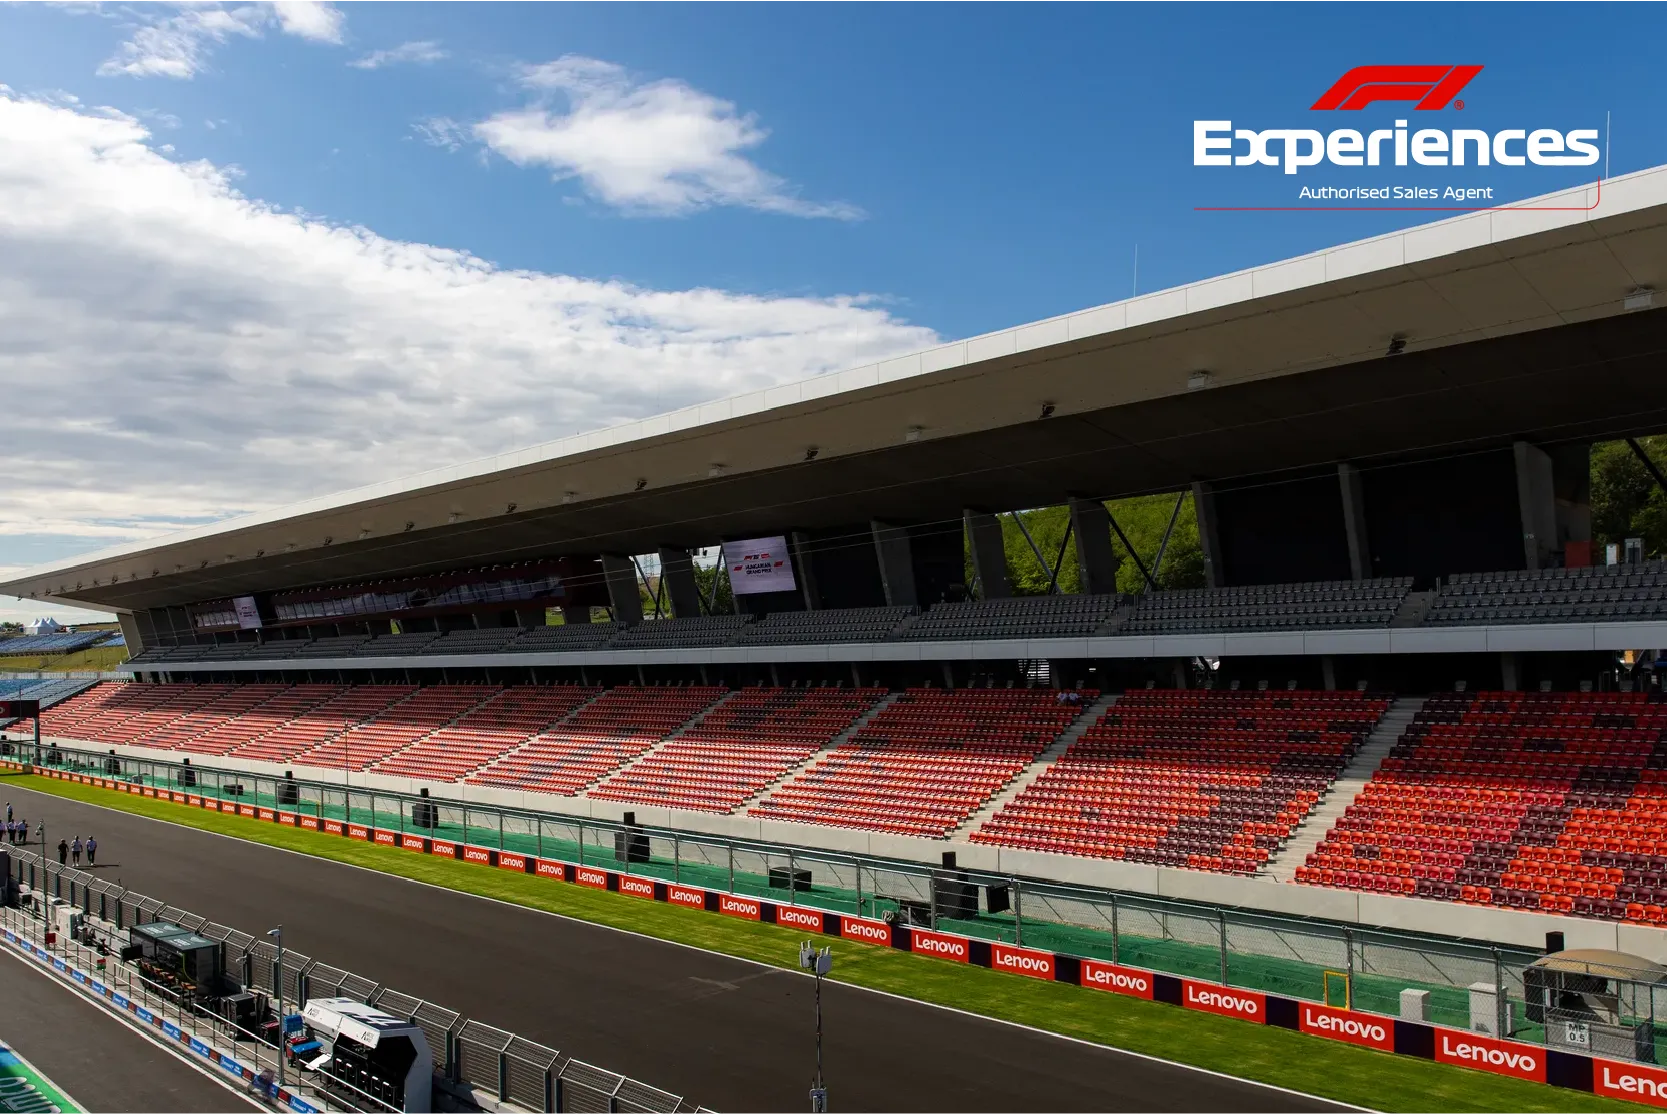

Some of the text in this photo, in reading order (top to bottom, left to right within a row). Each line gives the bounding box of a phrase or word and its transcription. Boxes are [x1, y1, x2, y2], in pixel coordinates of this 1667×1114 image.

[302, 818, 316, 827] Lenovo
[326, 823, 341, 832] Lenovo
[350, 828, 366, 837] Lenovo
[376, 832, 393, 842] Lenovo
[404, 838, 422, 848] Lenovo
[434, 843, 453, 854] Lenovo
[466, 849, 487, 860] Lenovo
[501, 855, 523, 867] Lenovo
[538, 862, 562, 875] Lenovo
[578, 870, 604, 884] Lenovo
[622, 878, 651, 893] Lenovo
[671, 888, 701, 903] Lenovo
[723, 898, 756, 914] Lenovo
[780, 909, 819, 926] Lenovo
[845, 920, 887, 940] Lenovo
[916, 935, 964, 956] Lenovo
[997, 950, 1049, 972] Lenovo
[1086, 965, 1147, 992] Lenovo
[1189, 986, 1257, 1014] Lenovo
[1306, 1009, 1386, 1041] Lenovo
[1570, 1032, 1585, 1042] 0.5
[1443, 1037, 1536, 1072] Lenovo
